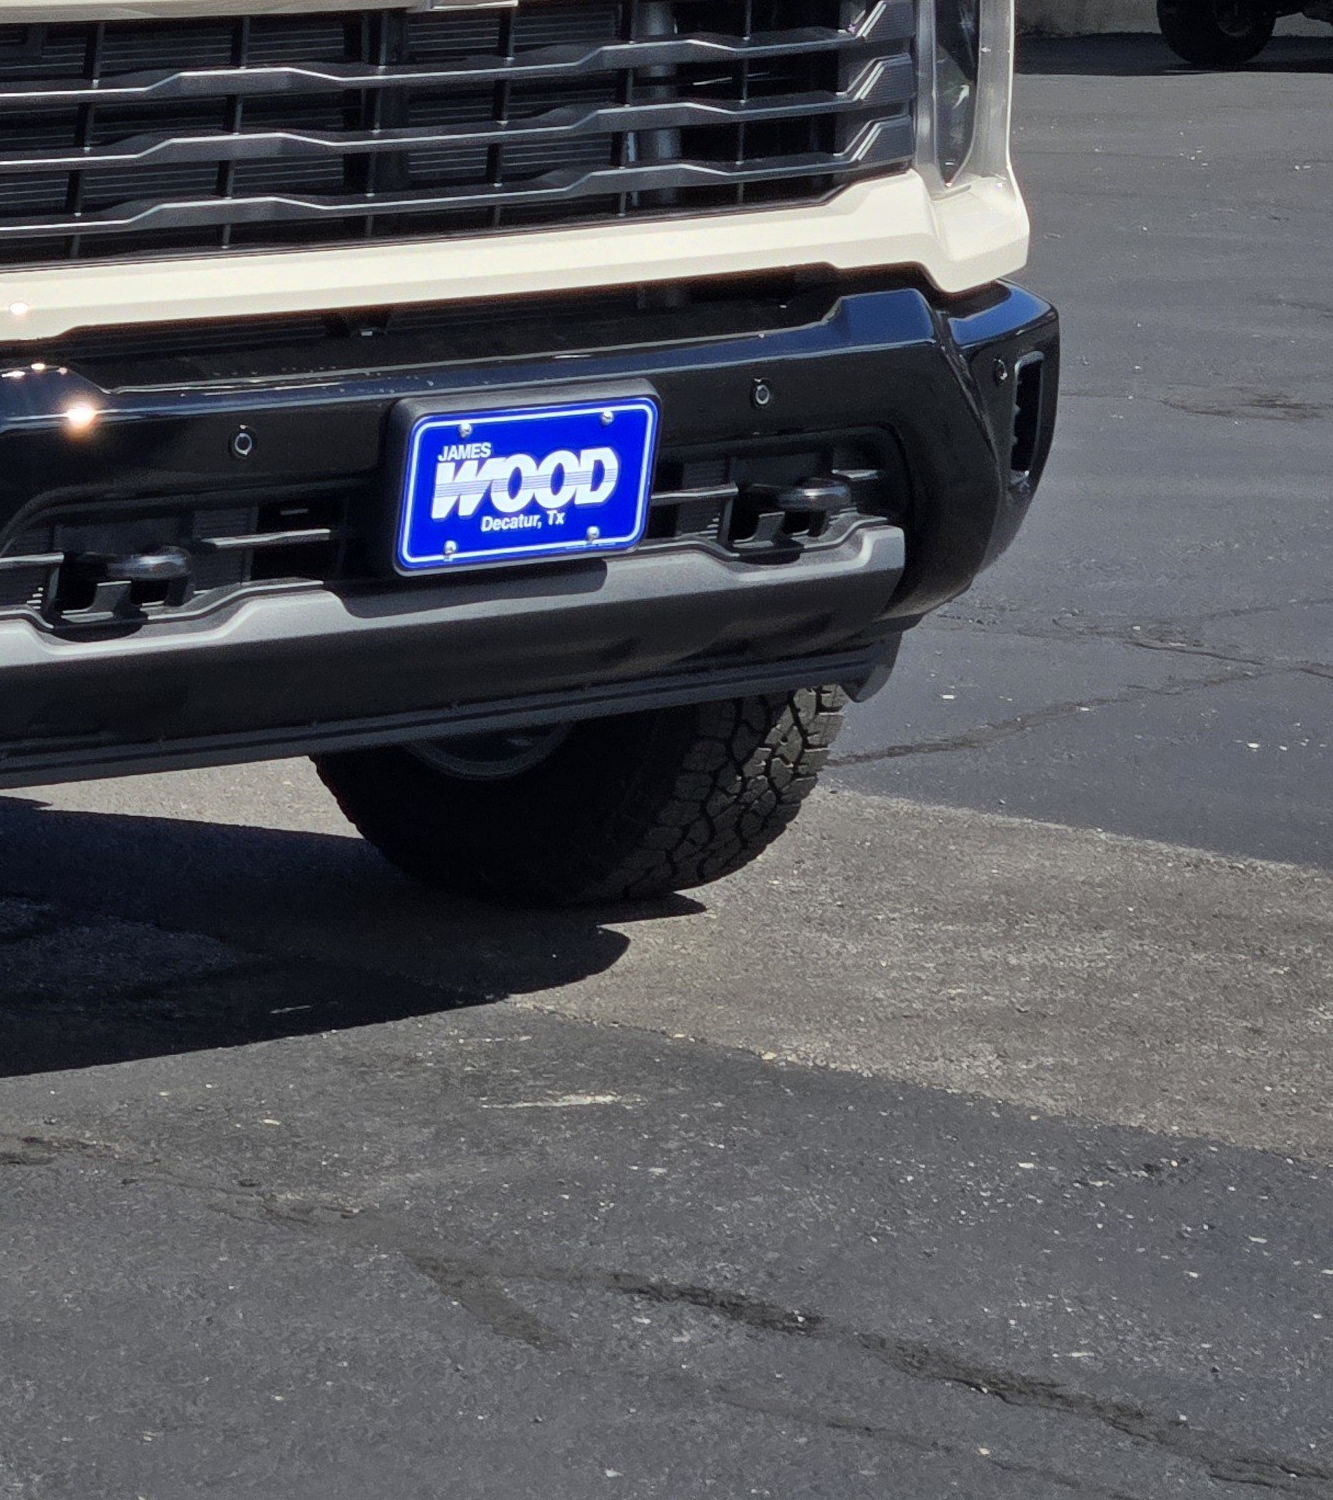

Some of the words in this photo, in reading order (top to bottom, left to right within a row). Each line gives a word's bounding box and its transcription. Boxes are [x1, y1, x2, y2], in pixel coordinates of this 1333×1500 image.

[437, 441, 492, 463] JAMES
[430, 446, 619, 520] WOOD
[480, 513, 543, 533] Decatur,
[546, 509, 565, 527] Tx
